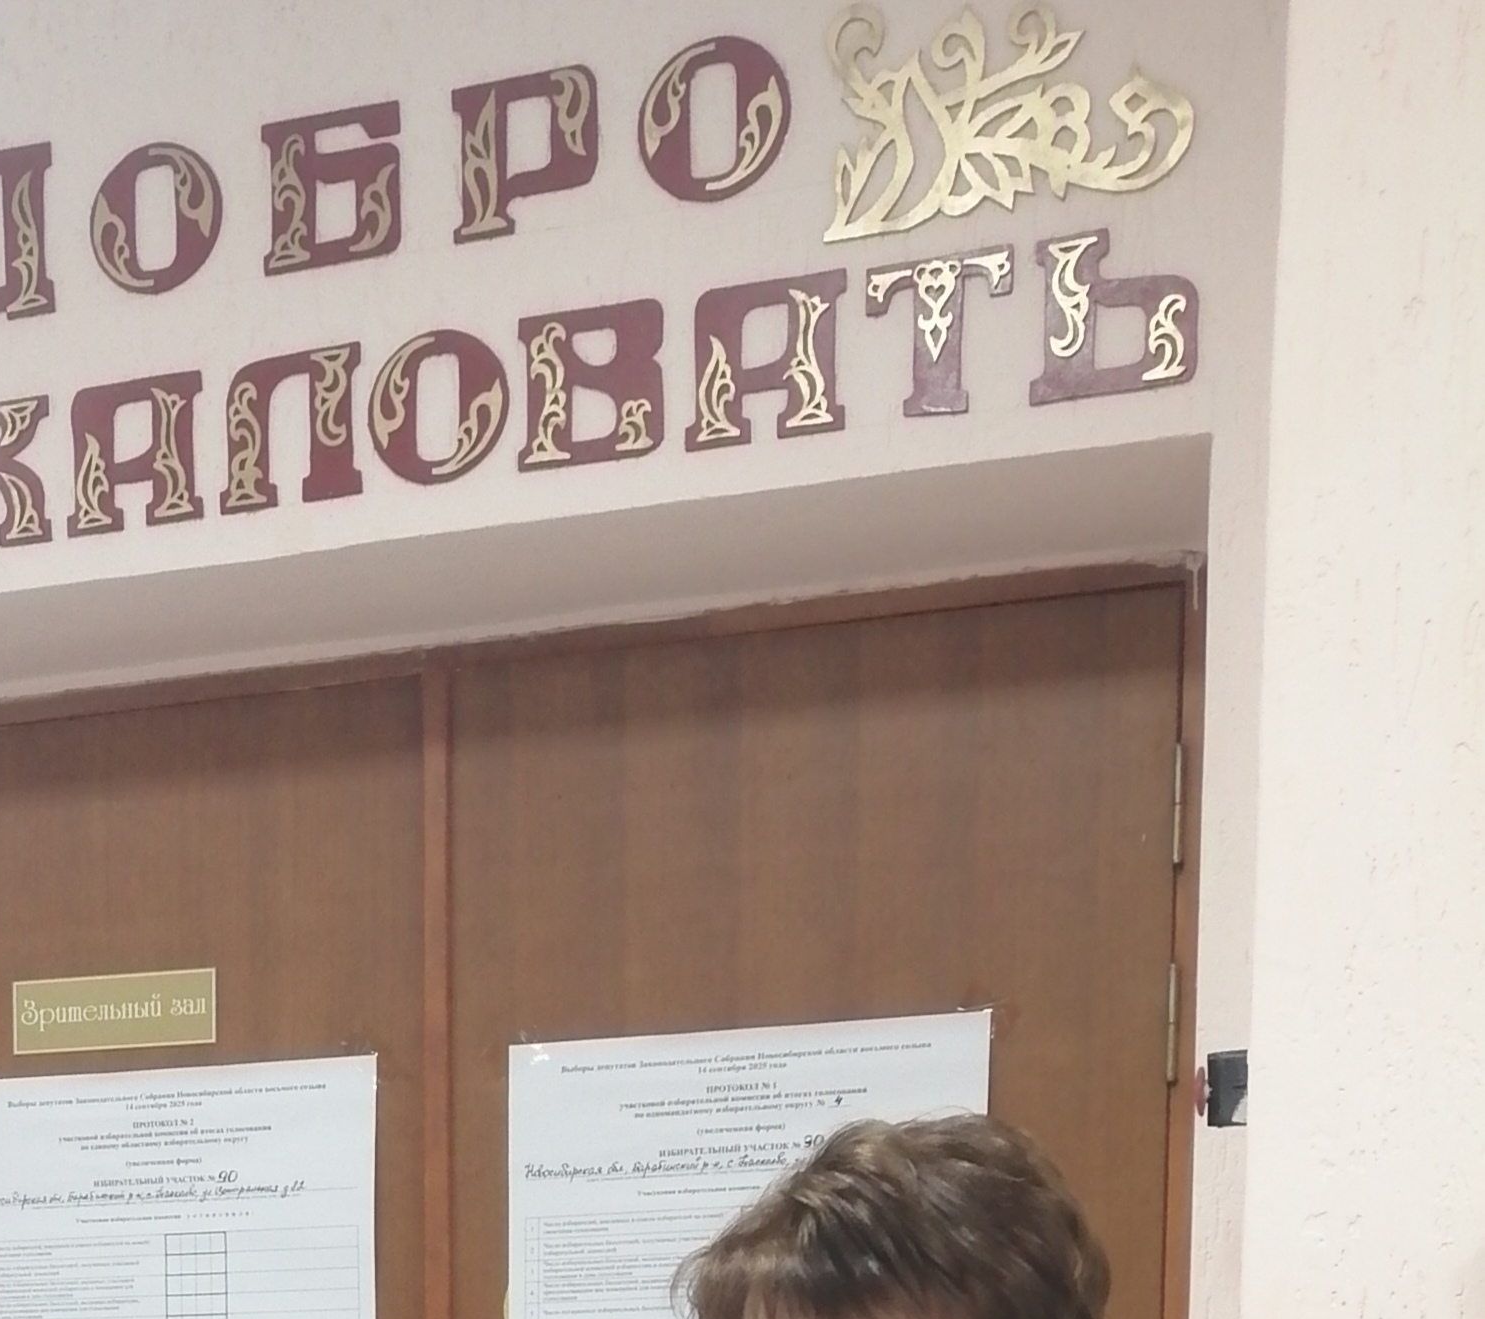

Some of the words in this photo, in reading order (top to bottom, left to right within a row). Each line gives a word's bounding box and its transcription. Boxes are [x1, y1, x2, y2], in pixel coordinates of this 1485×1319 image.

[21, 994, 162, 1032] Зрительный
[170, 997, 207, 1017] зал
[743, 1142, 790, 1151] УЧАСТОК
